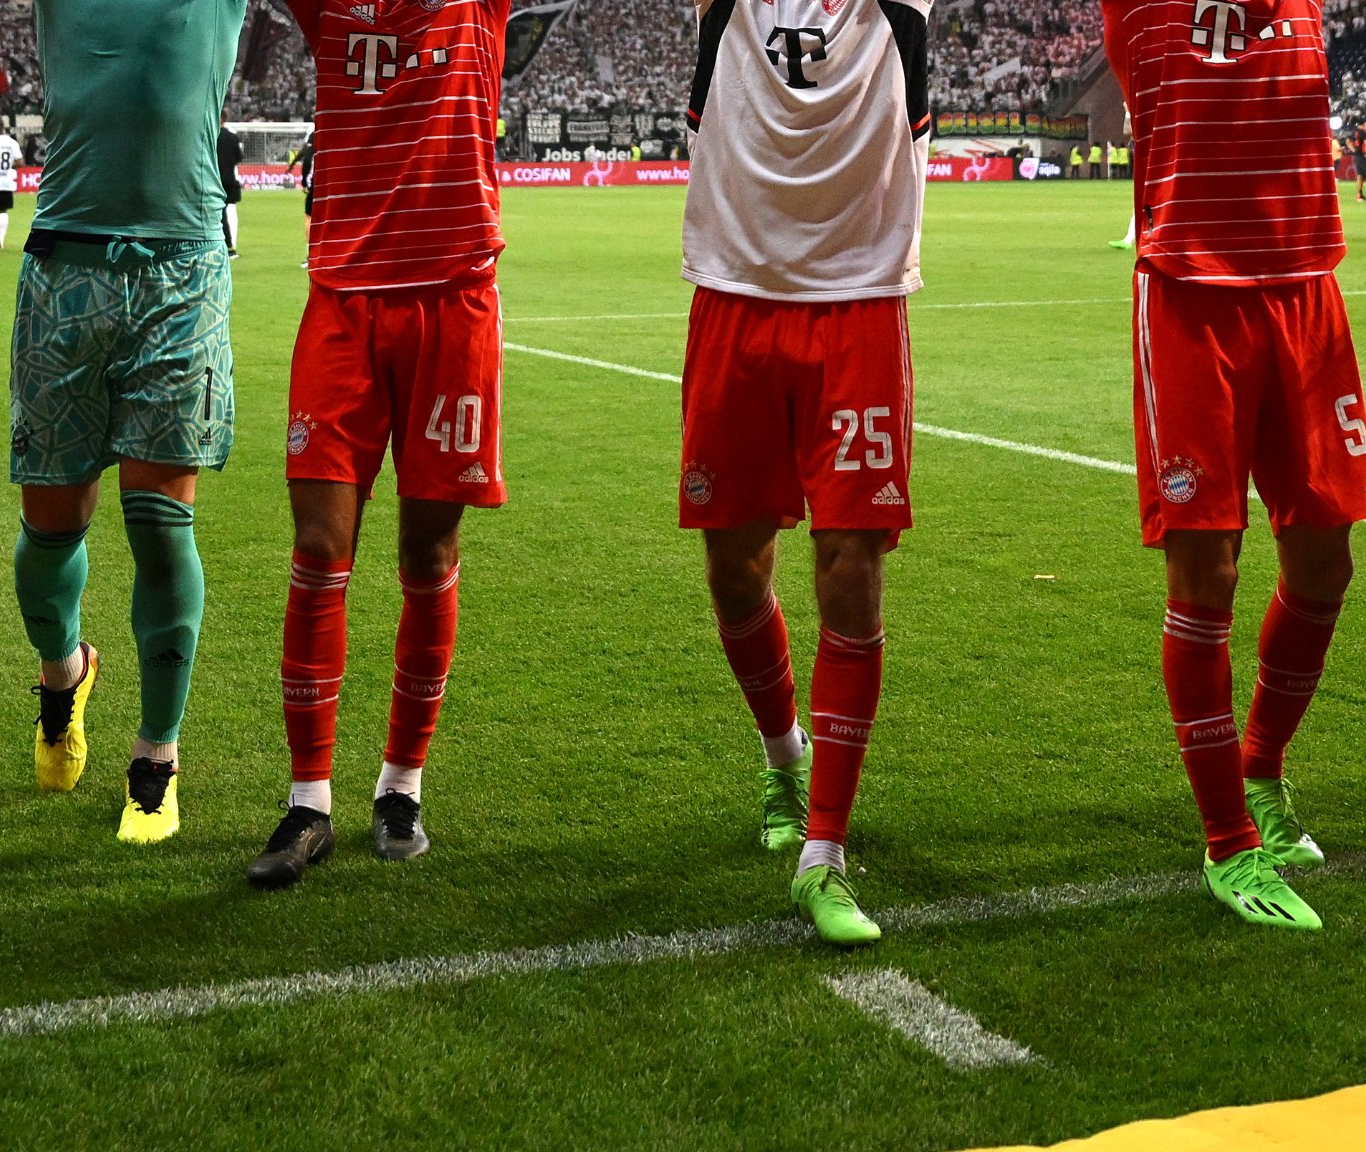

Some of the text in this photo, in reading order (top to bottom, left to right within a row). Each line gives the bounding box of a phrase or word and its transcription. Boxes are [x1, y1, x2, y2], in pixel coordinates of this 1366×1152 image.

[349, 6, 376, 26] adidas
[346, 33, 398, 95] T
[765, 26, 828, 90] T
[542, 147, 581, 162] Jobs
[514, 167, 571, 182] COSIFAN
[1038, 164, 1061, 177] aqila
[425, 394, 482, 453] 40
[831, 405, 894, 471] 25
[458, 474, 490, 484] adidas
[871, 495, 906, 506] adidas
[1163, 487, 1195, 504] MÜNCHEN
